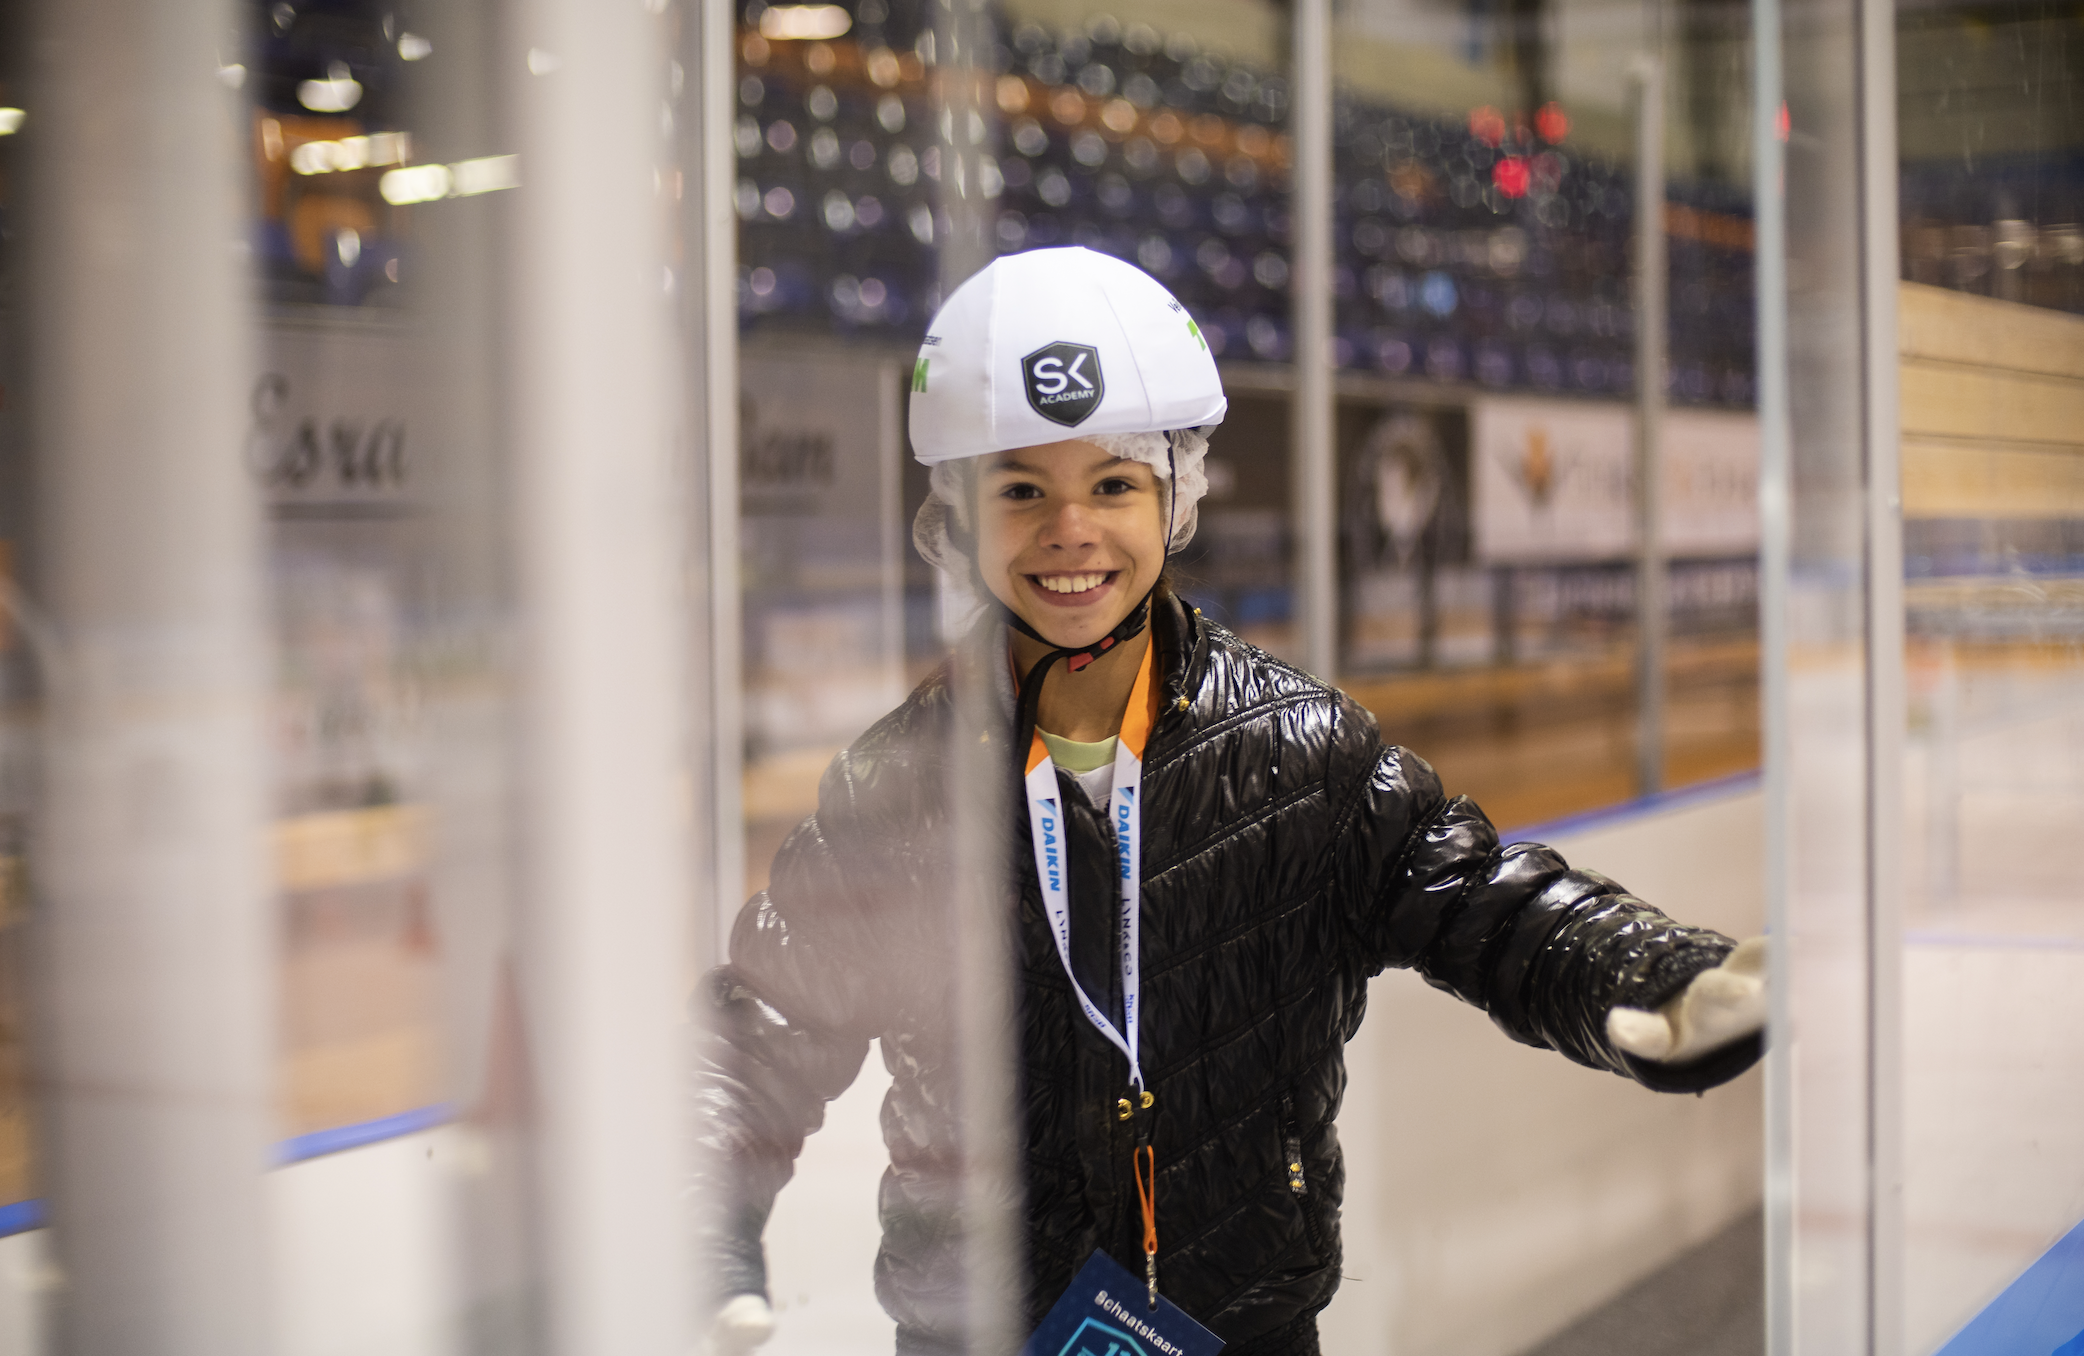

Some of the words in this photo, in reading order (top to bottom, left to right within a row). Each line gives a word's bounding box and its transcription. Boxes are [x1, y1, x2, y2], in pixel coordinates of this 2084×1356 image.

[1033, 353, 1094, 394] SK
[1039, 388, 1096, 406] ACADEMY
[1041, 817, 1061, 892] DAIKIN
[1118, 804, 1131, 880] DAIKIN
[1094, 1290, 1184, 1356] Schaatskaart
